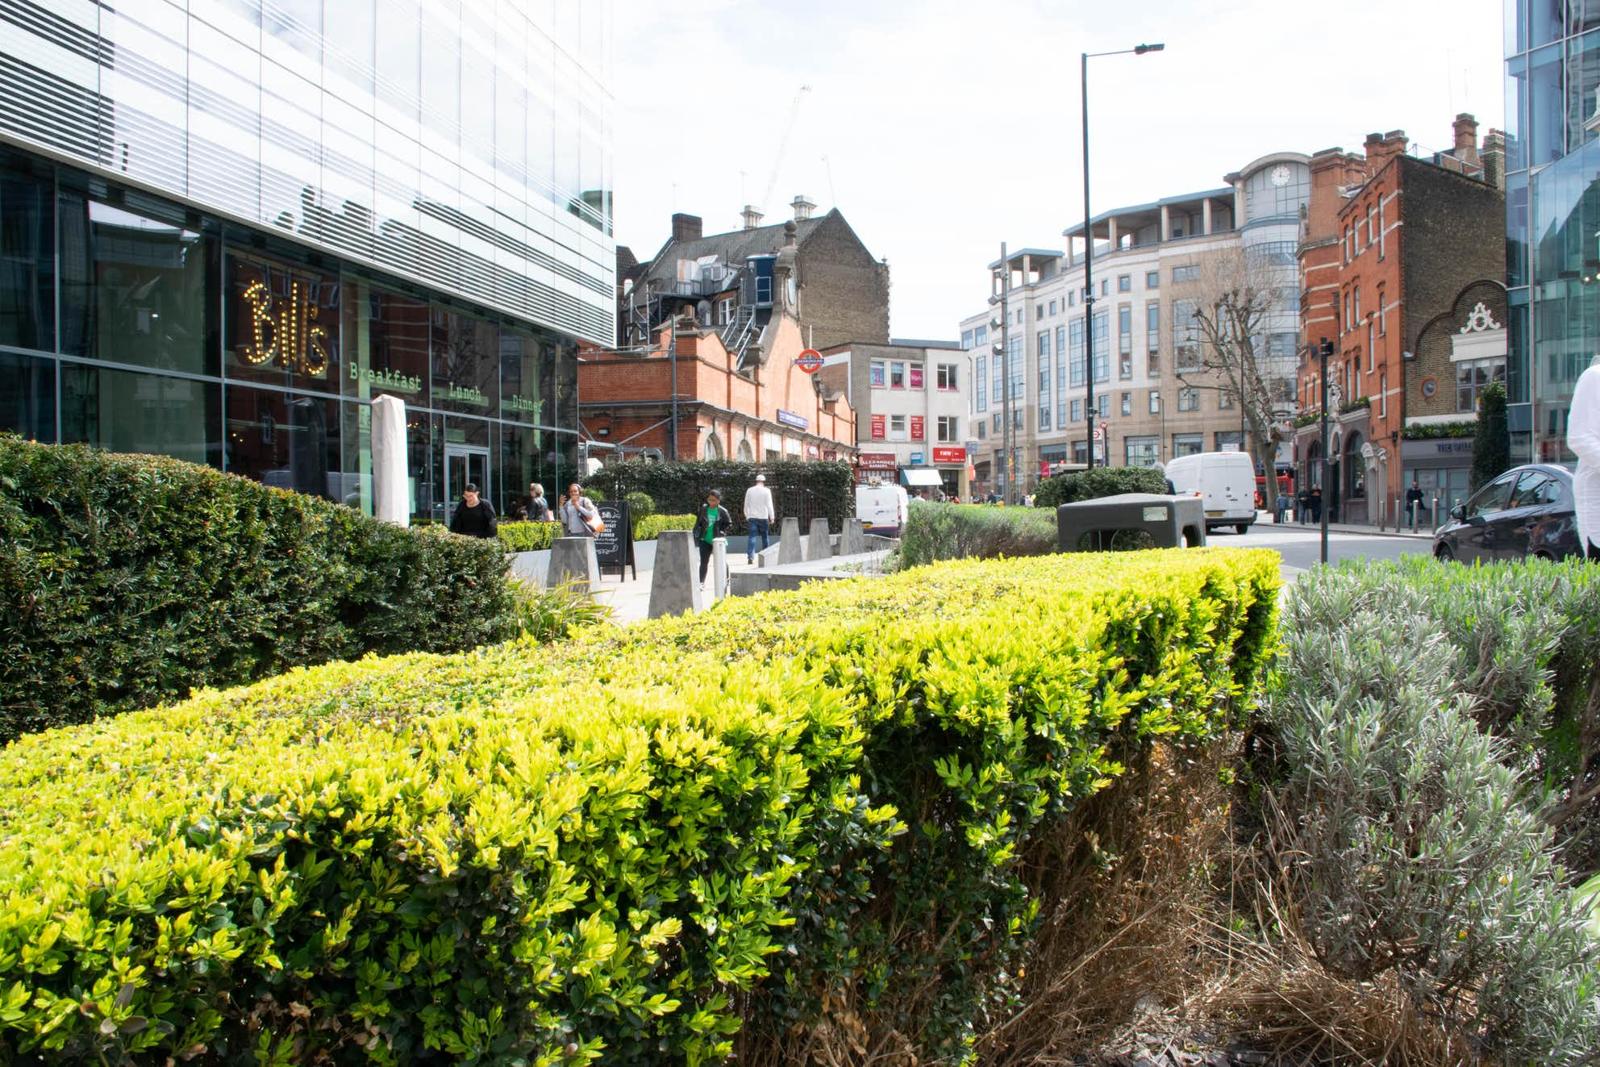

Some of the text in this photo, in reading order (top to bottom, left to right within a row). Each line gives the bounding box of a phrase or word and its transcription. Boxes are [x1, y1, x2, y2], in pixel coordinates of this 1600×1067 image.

[243, 280, 328, 374] Bill's
[350, 362, 544, 413] Breakfast Lunch Dinner
